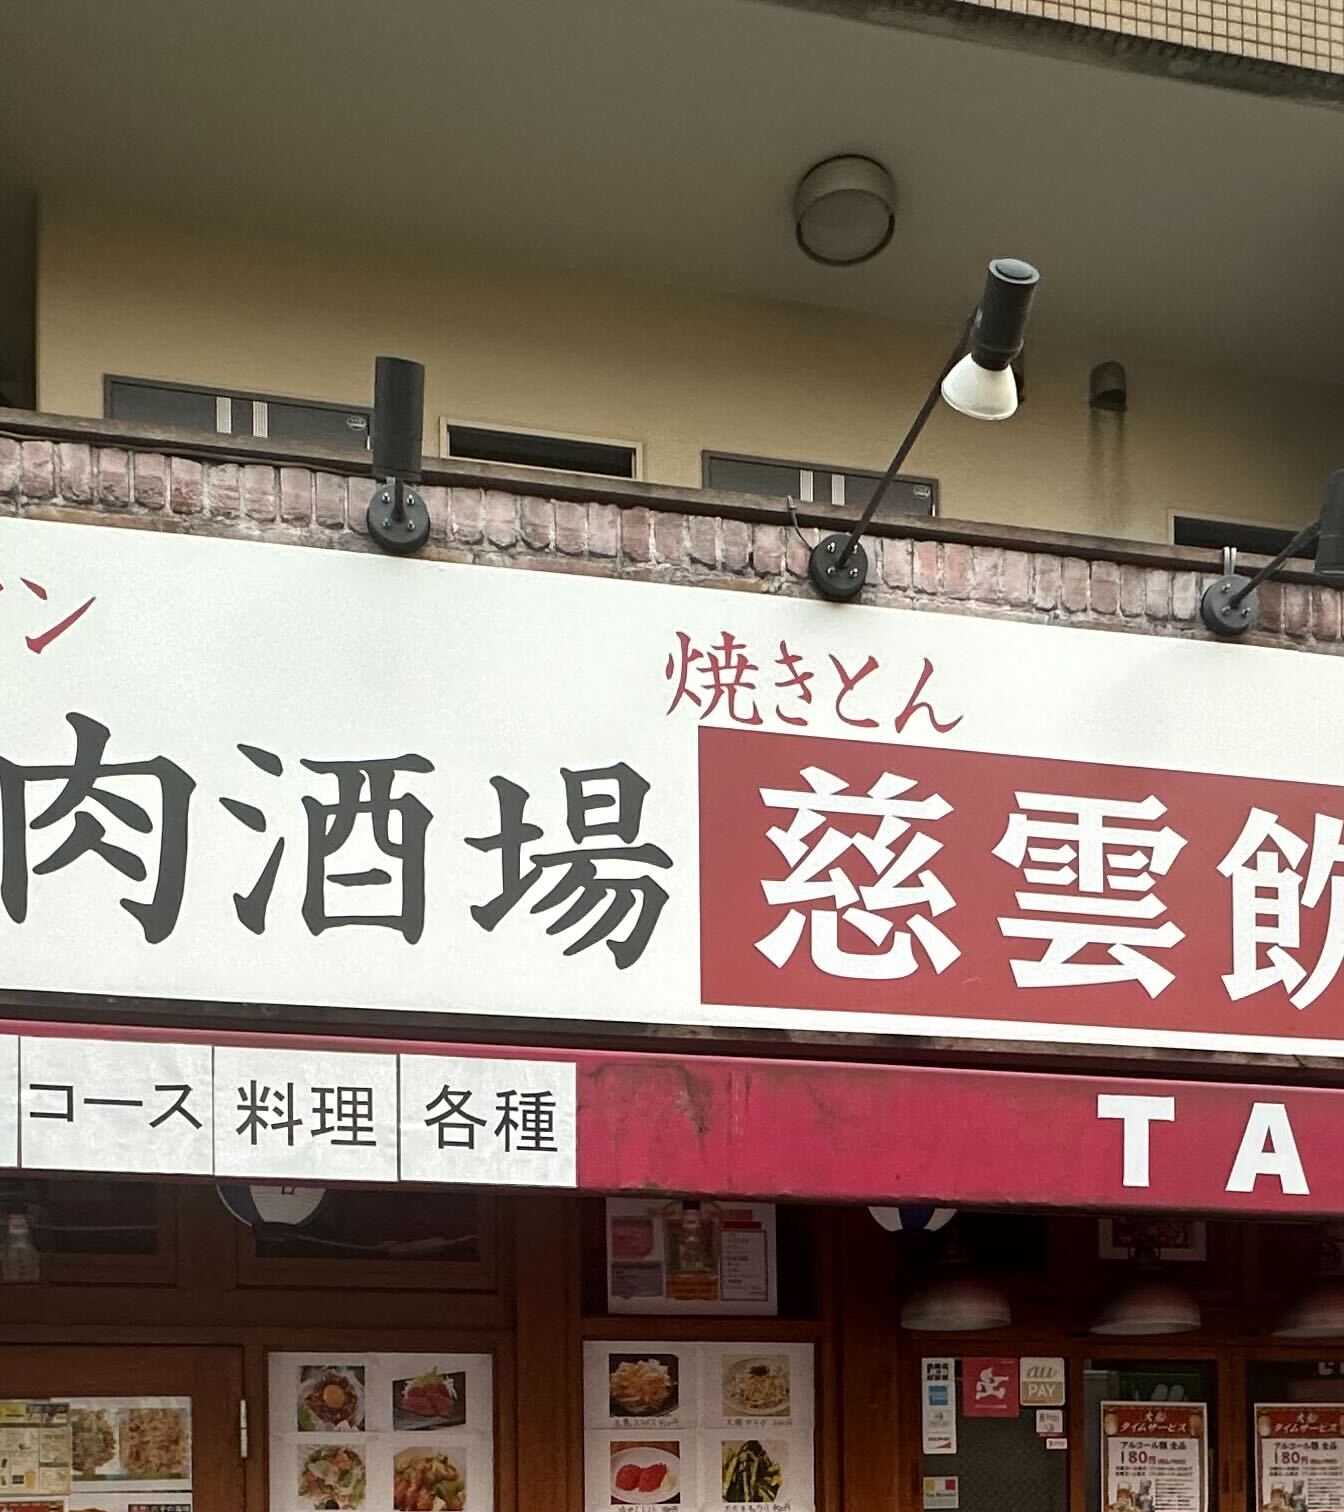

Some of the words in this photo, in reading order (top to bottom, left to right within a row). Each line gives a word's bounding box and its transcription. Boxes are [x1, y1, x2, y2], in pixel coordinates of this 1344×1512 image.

[664, 629, 963, 734] 焼きとん
[29, 1083, 203, 1130] コース
[235, 1079, 376, 1148] 料理
[423, 1083, 558, 1153] 各種
[1027, 1366, 1056, 1379] au
[1028, 1385, 1056, 1397] PAY
